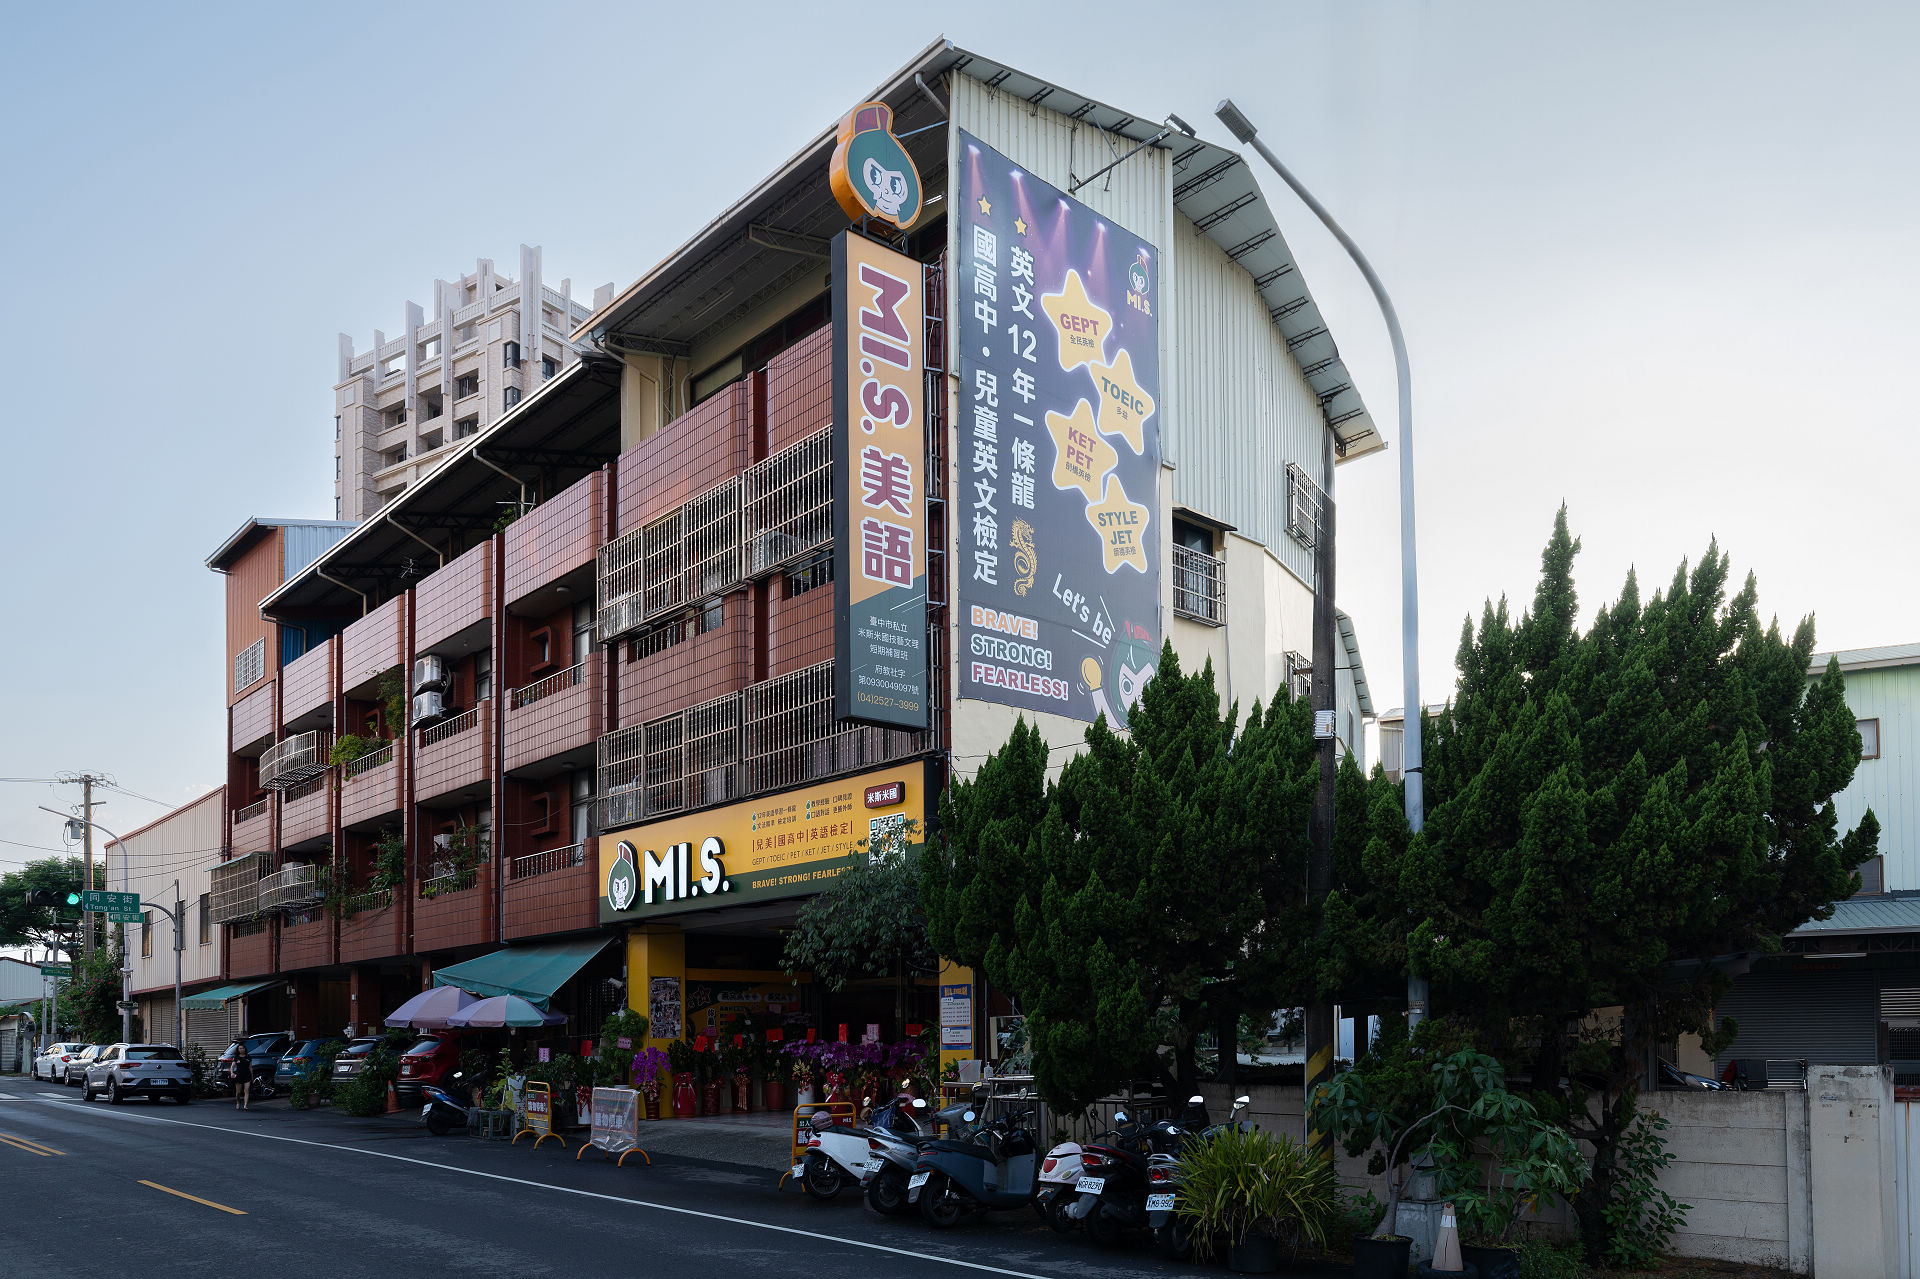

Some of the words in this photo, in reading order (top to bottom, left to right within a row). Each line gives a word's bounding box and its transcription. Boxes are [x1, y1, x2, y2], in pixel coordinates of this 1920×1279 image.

[1060, 313, 1099, 336] GEPT
[1101, 375, 1144, 416] TOEIC
[1068, 426, 1097, 453] KET
[1066, 444, 1094, 470] PET
[860, 444, 913, 590] 美語
[1097, 510, 1139, 527] STYLE
[1110, 529, 1133, 545] JET
[1052, 573, 1090, 624] Let's
[1092, 610, 1113, 645] be
[971, 605, 1038, 640] BRAVE!
[970, 633, 1052, 670] STRONG!
[971, 662, 1069, 701] FEARLESS!
[857, 690, 919, 712] (04)2527-3999
[752, 856, 766, 866] GEPT
[770, 852, 785, 863] TOEIC
[790, 850, 800, 860] PET
[805, 847, 816, 857] KET
[820, 845, 831, 855] JET
[836, 841, 853, 852] STYLE
[644, 837, 731, 905] MI.S.
[752, 877, 777, 889] BRAVE!
[778, 872, 811, 885] STRONG!
[89, 892, 133, 904] 同安街
